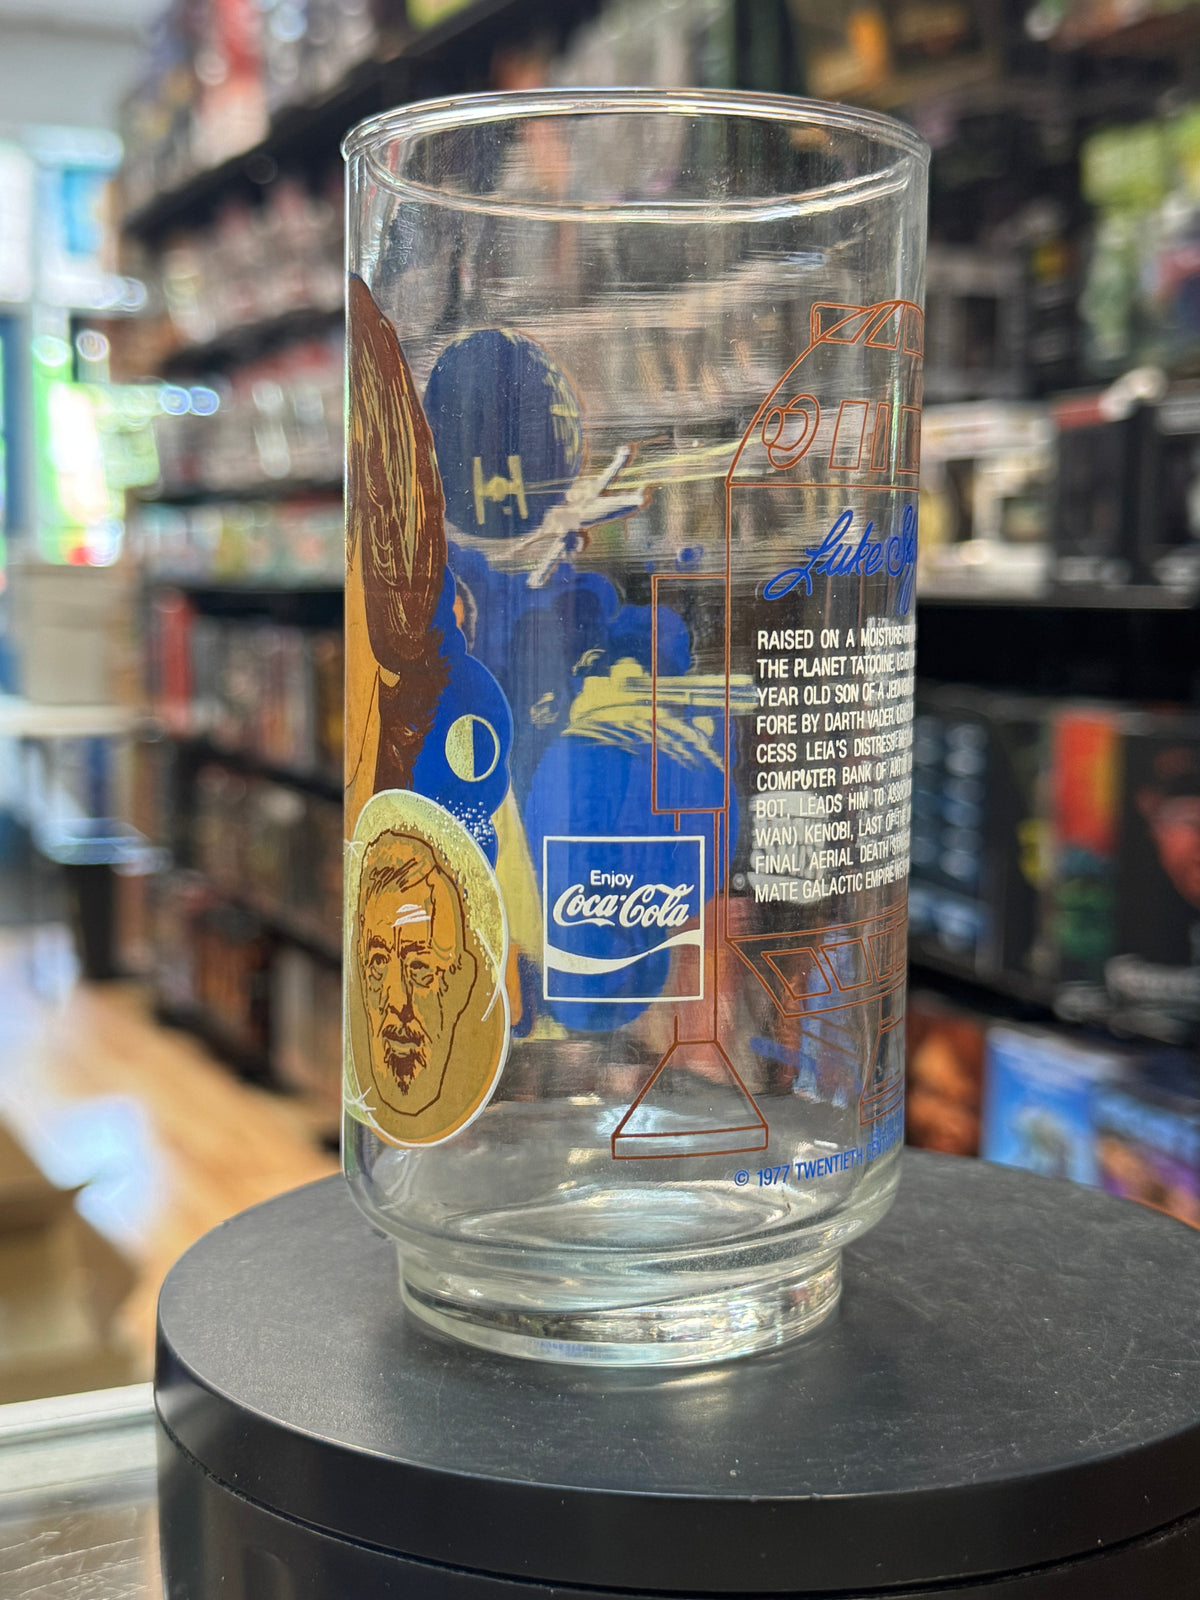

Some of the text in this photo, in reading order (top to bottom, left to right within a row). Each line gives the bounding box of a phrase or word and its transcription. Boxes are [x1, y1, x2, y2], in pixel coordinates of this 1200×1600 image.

[763, 509, 884, 600] Luke
[757, 629, 814, 650] RAISED
[820, 629, 840, 649] ON
[846, 629, 856, 648] A
[757, 659, 789, 679] THE
[794, 656, 847, 678] PLANET
[756, 687, 799, 707] YEAR
[804, 685, 831, 705] OLD
[835, 683, 860, 704] SON
[862, 682, 876, 702] OF
[877, 682, 885, 700] A
[756, 714, 798, 735] FORE
[801, 713, 820, 734] BY
[824, 711, 865, 732] DARTH
[756, 743, 797, 764] CESS
[806, 739, 848, 761] LEIA'S
[854, 733, 895, 758] DISTRESS
[756, 768, 836, 792] COMPUTER
[842, 765, 872, 786] BANK
[875, 762, 888, 781] OF
[756, 798, 791, 819] BOT,
[800, 794, 843, 816] LEADS
[848, 791, 869, 811] HIM
[873, 788, 885, 807] TO
[755, 826, 797, 848] WAN)
[804, 821, 853, 844] KENOBI,
[858, 815, 882, 837] LAST
[755, 854, 800, 874] FINAL
[809, 847, 854, 870] AERIAL
[860, 840, 889, 863] DEATH
[590, 869, 634, 888] Enjoy
[755, 882, 798, 903] MATE
[802, 872, 863, 899] GALACTIC
[865, 864, 895, 890] EMPIRE
[757, 1165, 791, 1187] 1977
[795, 1147, 863, 1181] TWENTIETH
